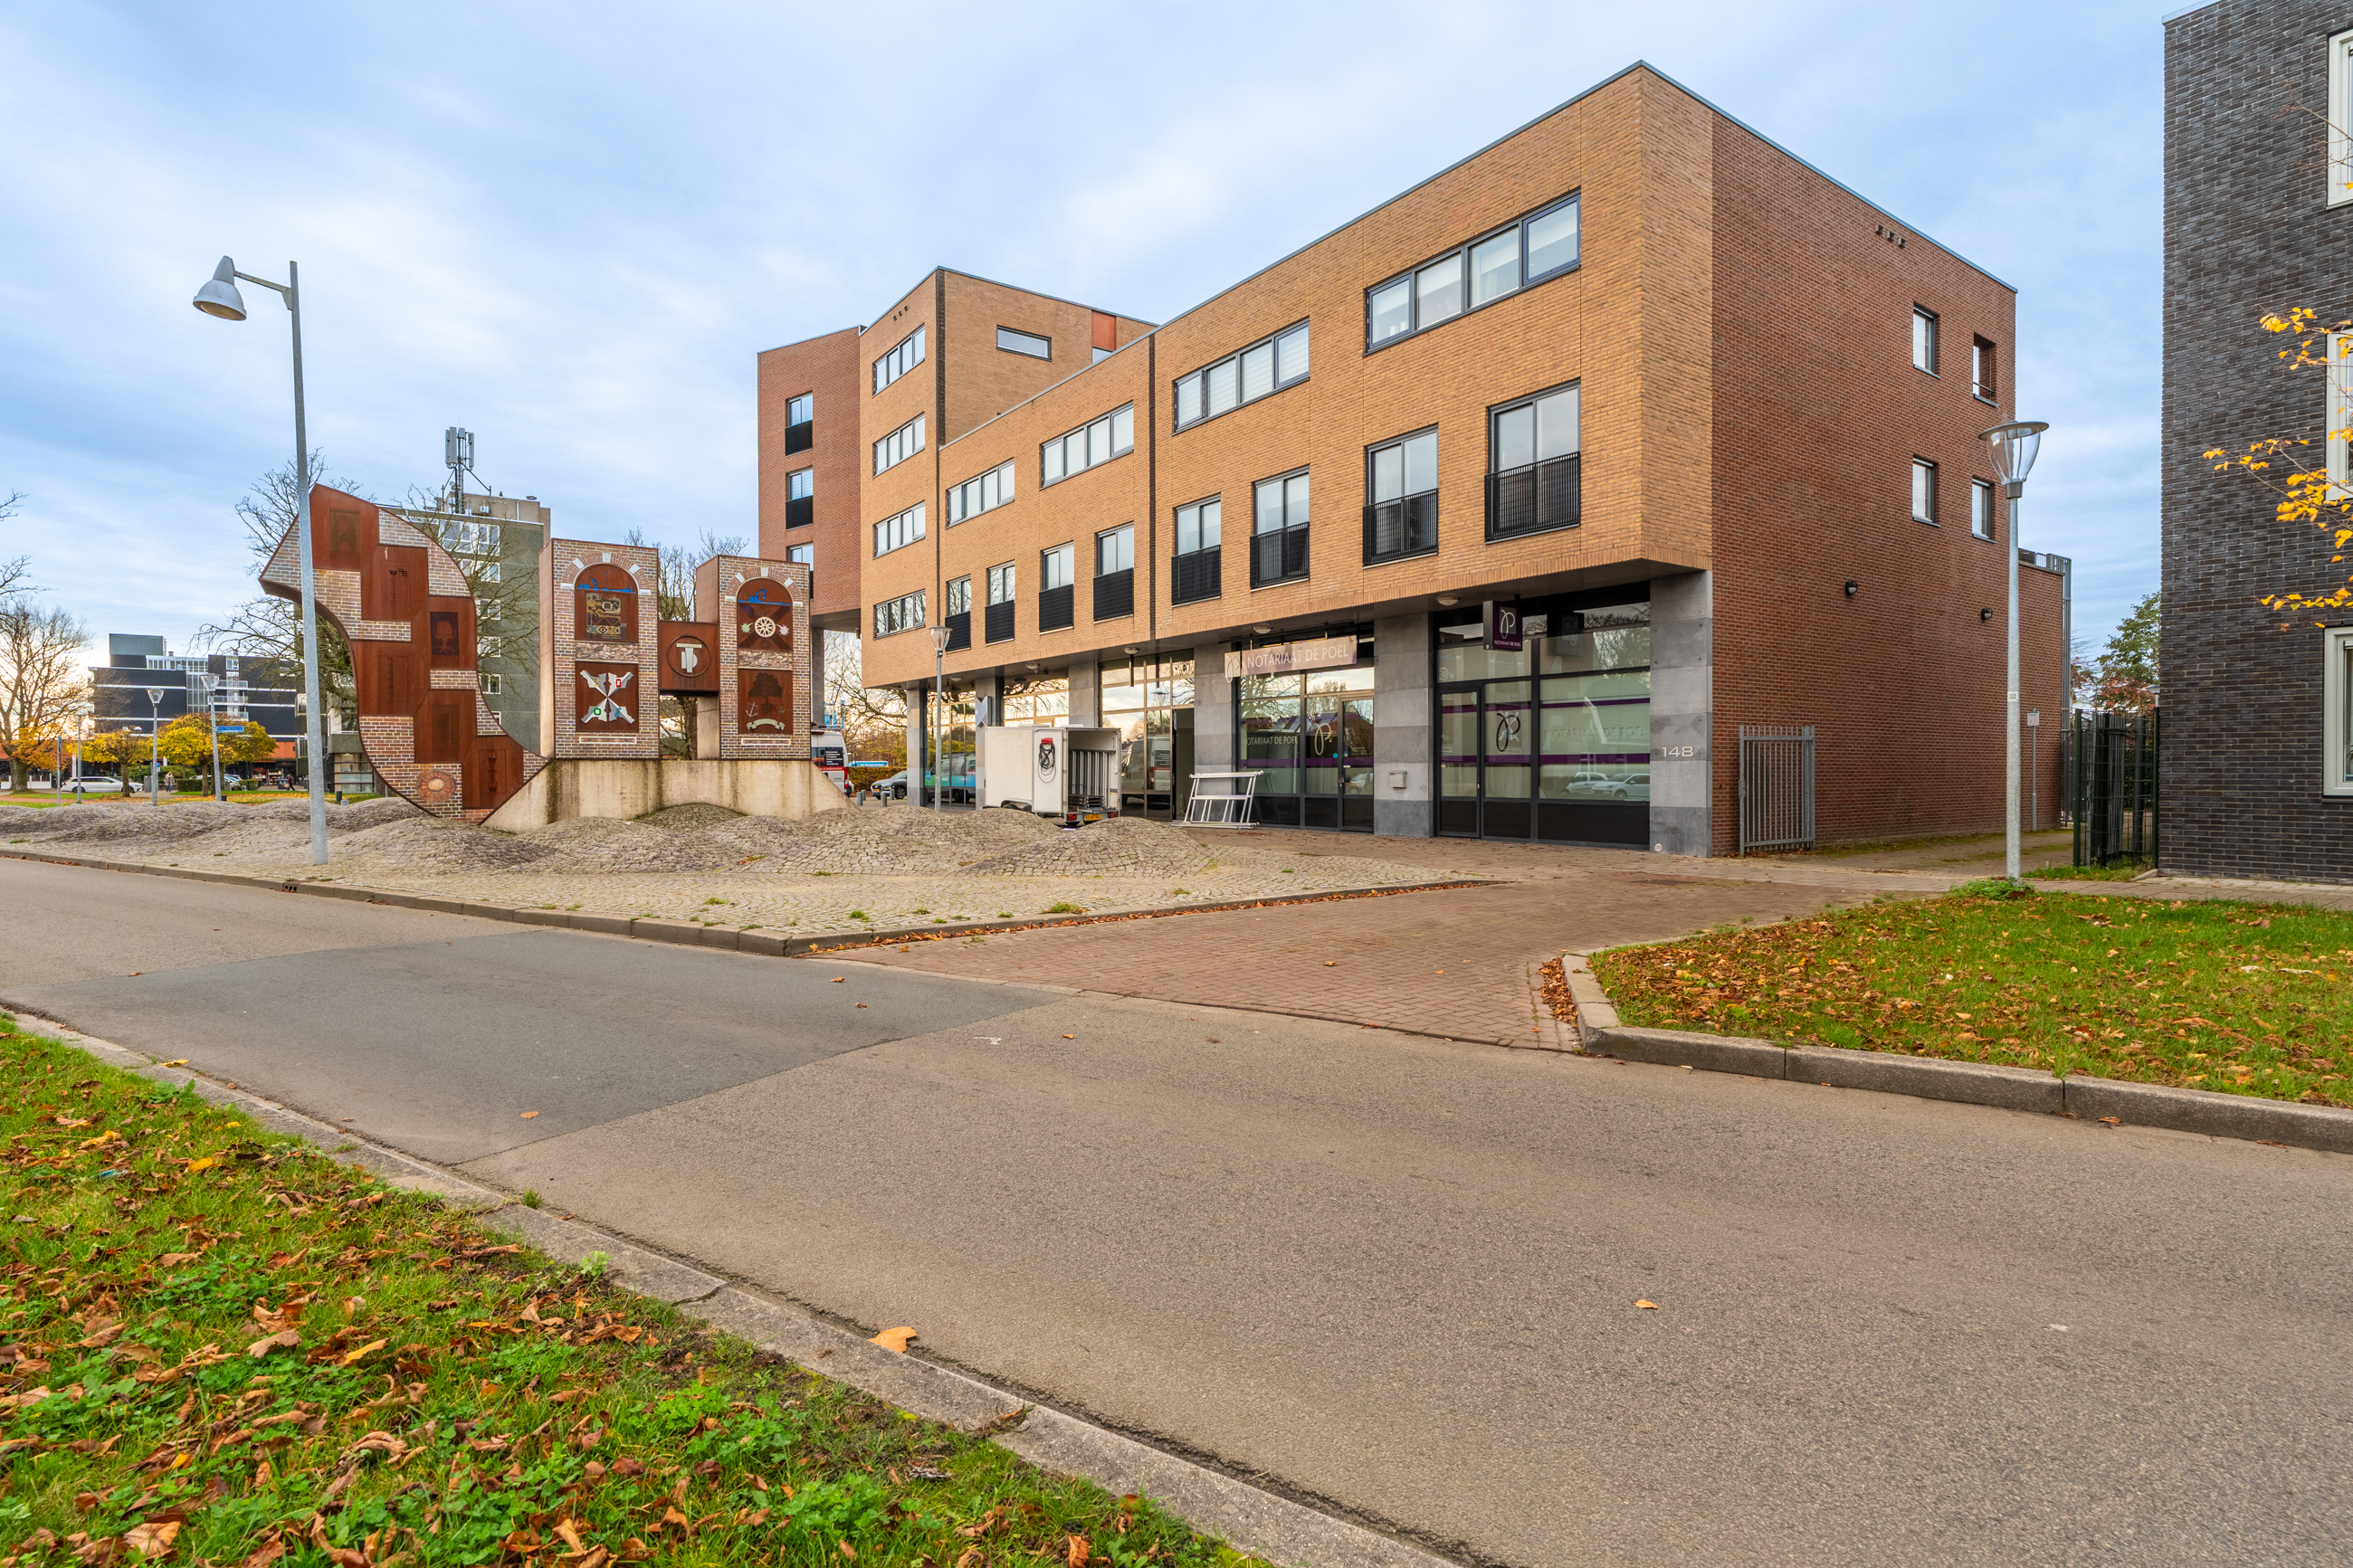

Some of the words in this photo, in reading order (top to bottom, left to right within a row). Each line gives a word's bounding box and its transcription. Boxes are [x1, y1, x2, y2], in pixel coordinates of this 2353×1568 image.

[1246, 650, 1303, 669] NOTARIAAT
[1305, 648, 1319, 662] DE
[1322, 644, 1349, 660] POEL
[1243, 736, 1274, 746] OTARIAAT
[1274, 736, 1282, 745] DE
[1283, 736, 1299, 745] POEL
[1662, 746, 1694, 757] 148
